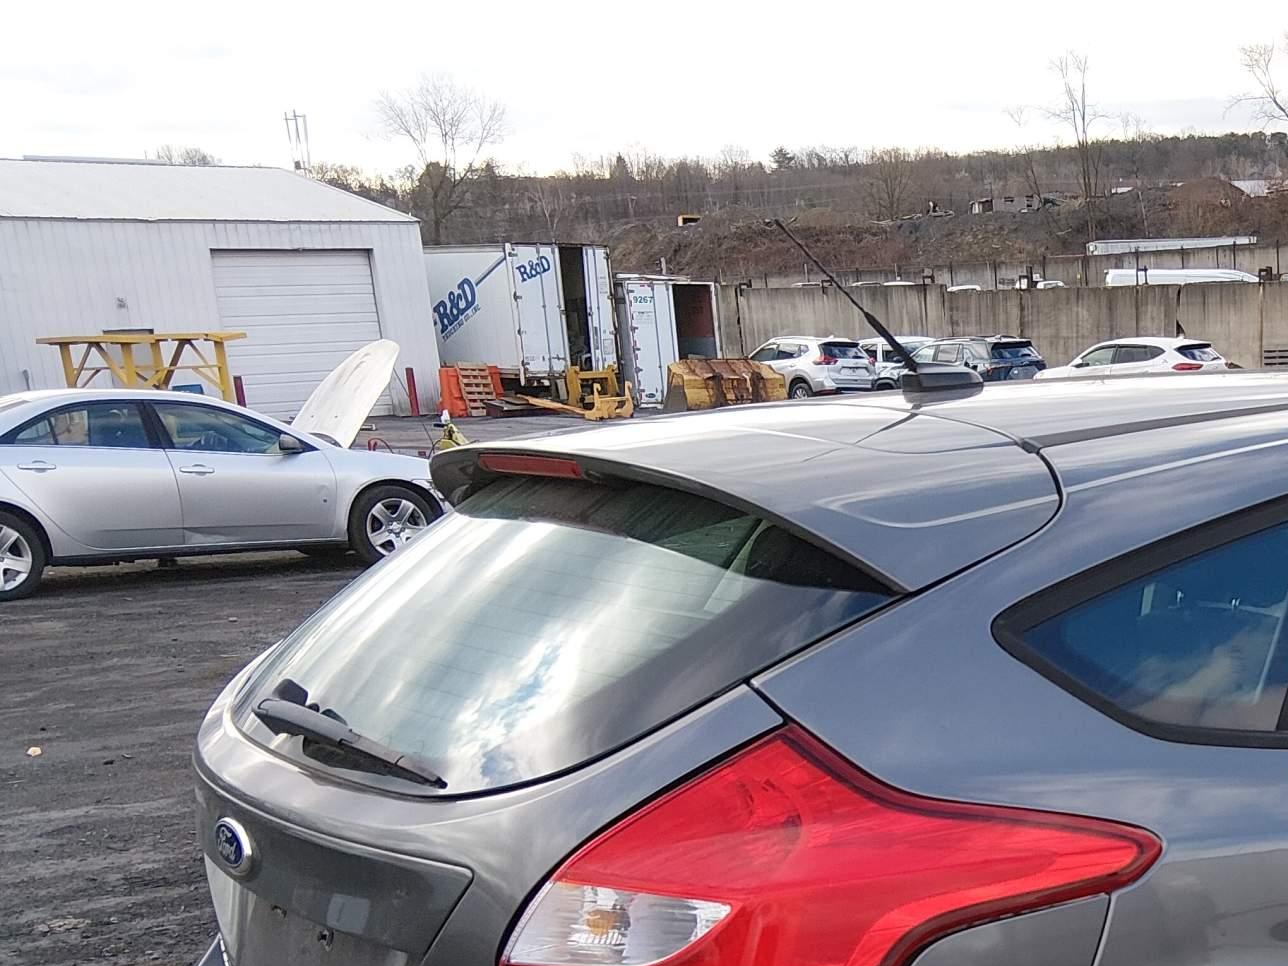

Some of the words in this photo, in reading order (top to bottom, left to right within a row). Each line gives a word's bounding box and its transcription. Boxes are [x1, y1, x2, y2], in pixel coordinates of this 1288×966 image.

[515, 255, 551, 283] R&D
[433, 277, 476, 335] R&D
[632, 295, 654, 304] 9267
[217, 826, 238, 862] Ford
